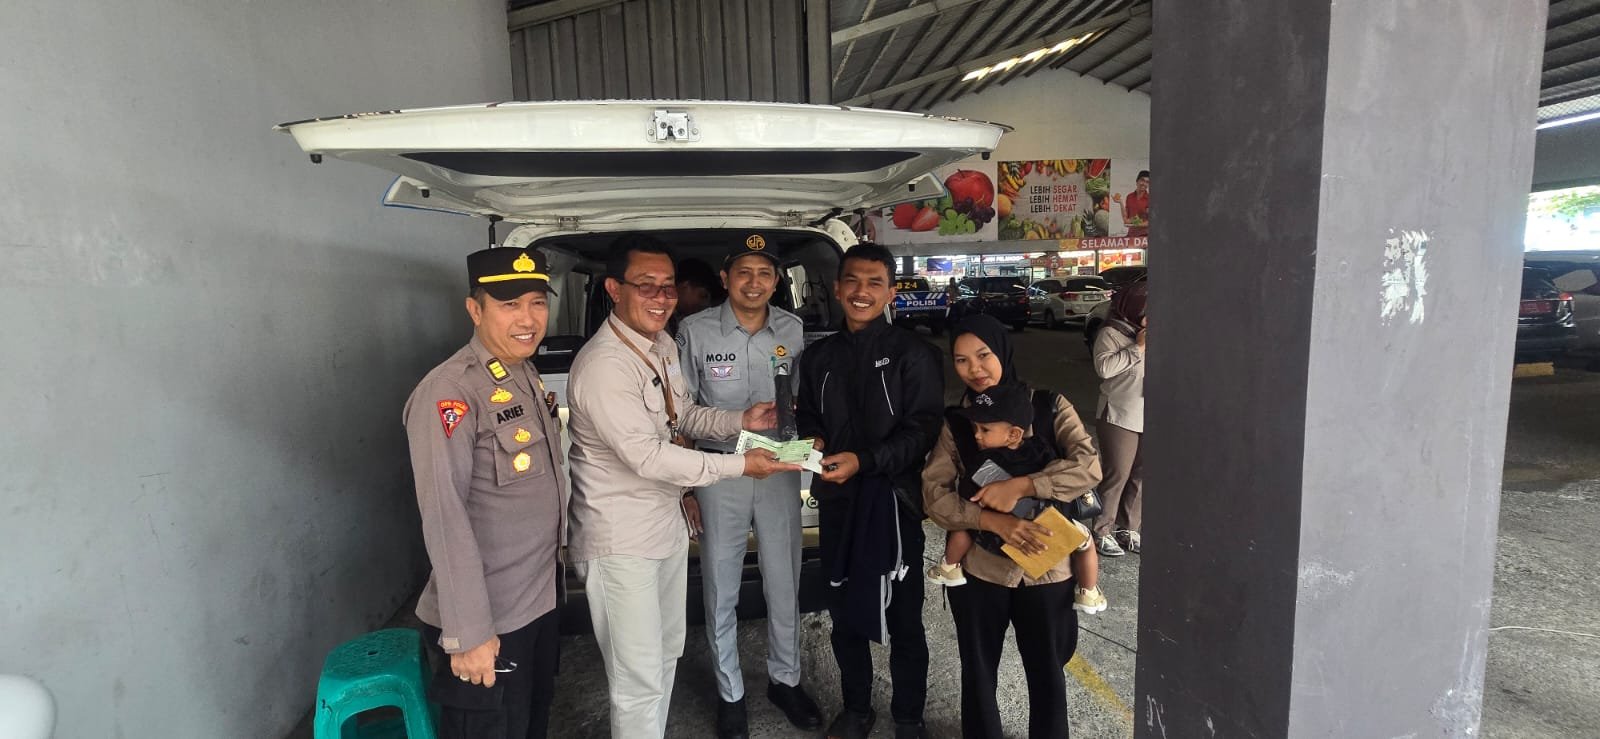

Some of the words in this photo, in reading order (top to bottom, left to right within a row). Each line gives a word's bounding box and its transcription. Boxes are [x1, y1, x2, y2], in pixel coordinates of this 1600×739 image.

[1030, 185, 1050, 194] LEBIH
[1053, 184, 1077, 193] SEGAR
[1029, 195, 1050, 203] LEBIH
[1053, 194, 1078, 203] HEMAT
[1030, 204, 1051, 213] LEBIH
[1053, 204, 1076, 212] DEKAT
[1081, 237, 1130, 249] SELAMAT
[706, 353, 736, 362] MOJO
[496, 404, 524, 424] ARIEF
